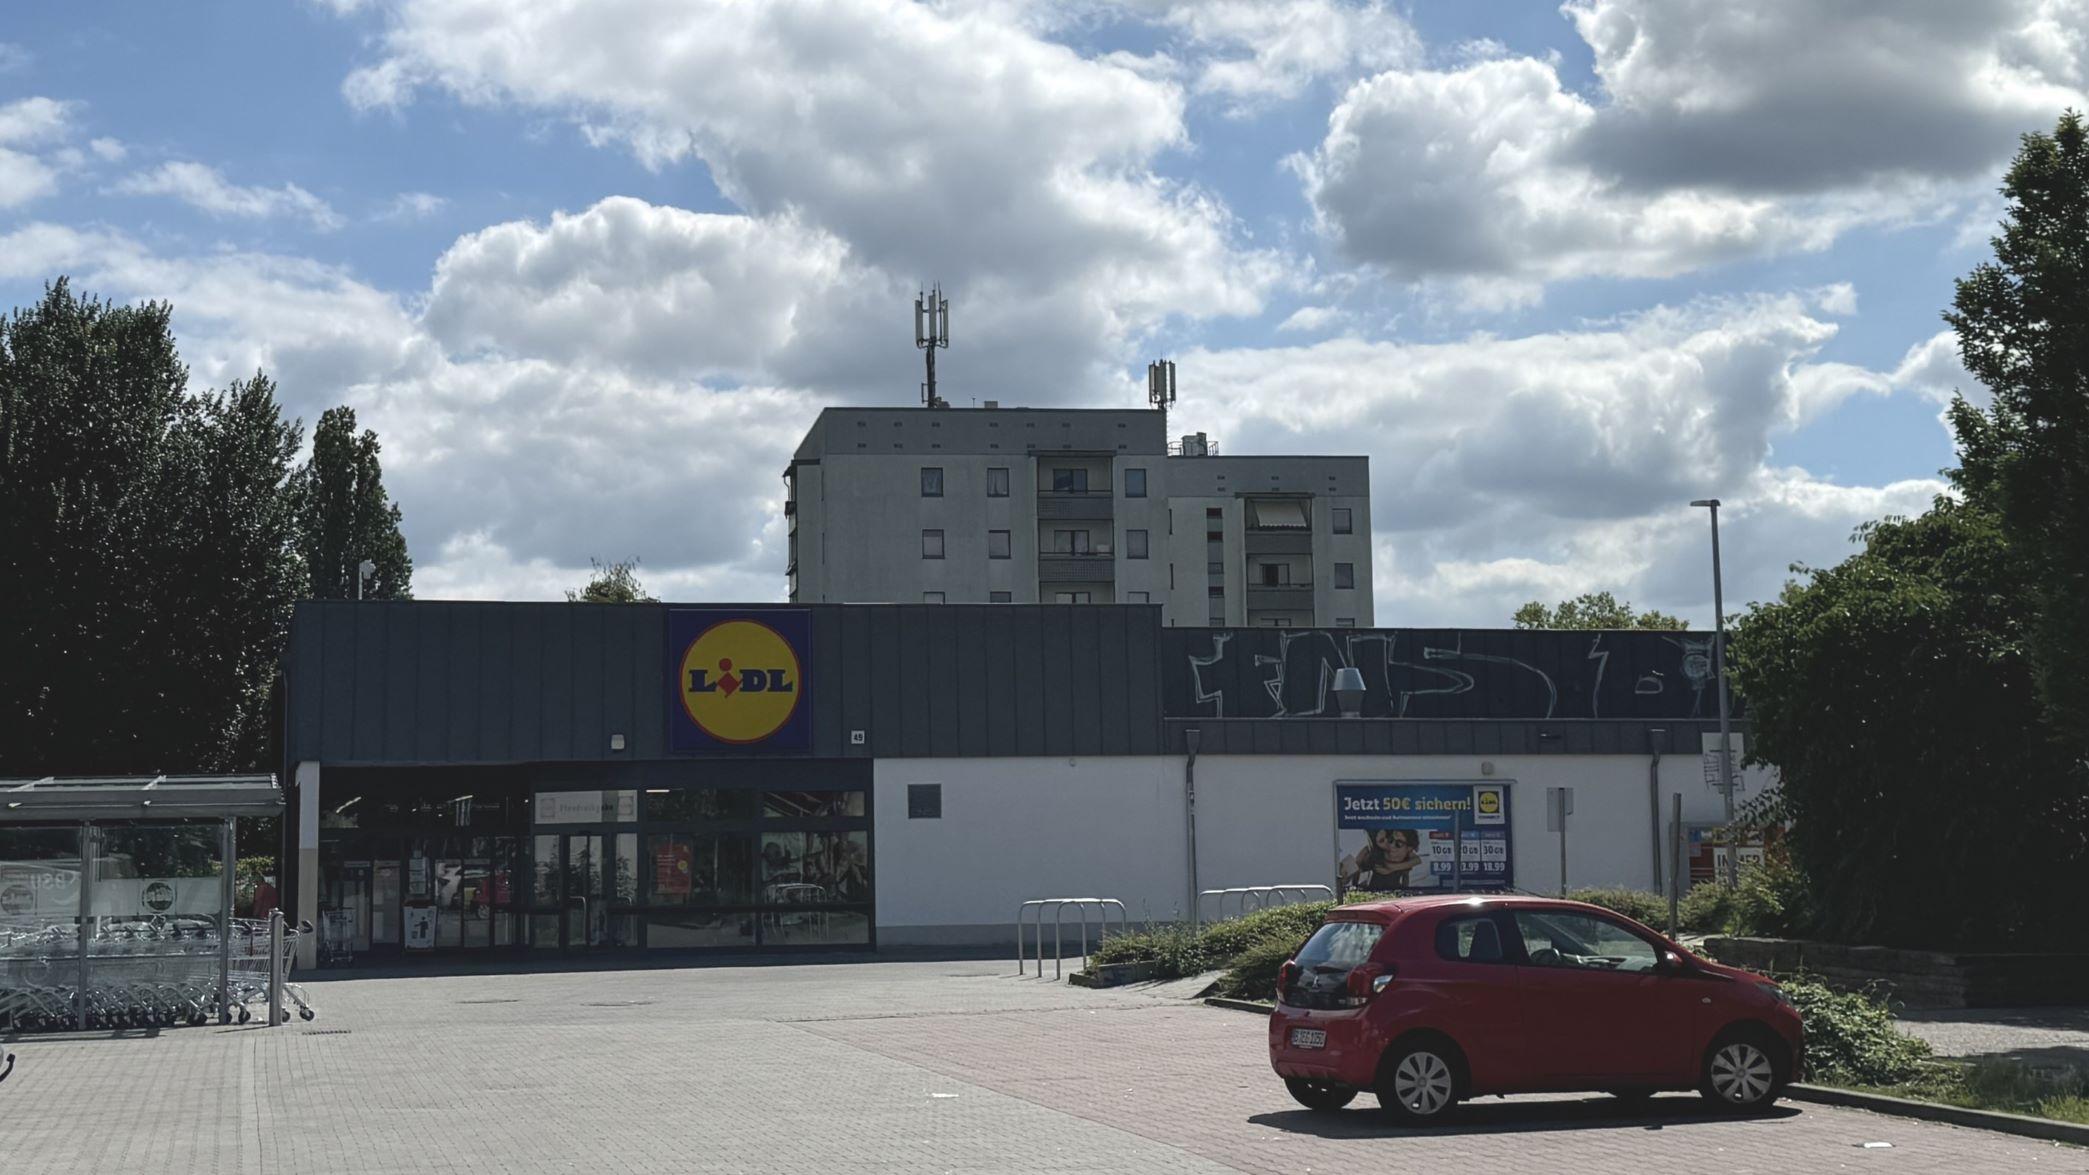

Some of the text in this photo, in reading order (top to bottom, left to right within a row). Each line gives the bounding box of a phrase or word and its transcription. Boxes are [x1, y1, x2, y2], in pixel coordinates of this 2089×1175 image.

[1344, 796, 1471, 811] Jetzt 50€ sichern!
[1432, 845, 1452, 855] 10 GB
[1460, 845, 1468, 855] 0
[1483, 845, 1494, 855] 30
[1433, 862, 1452, 872] 8.99
[1483, 862, 1505, 872] 18.99
